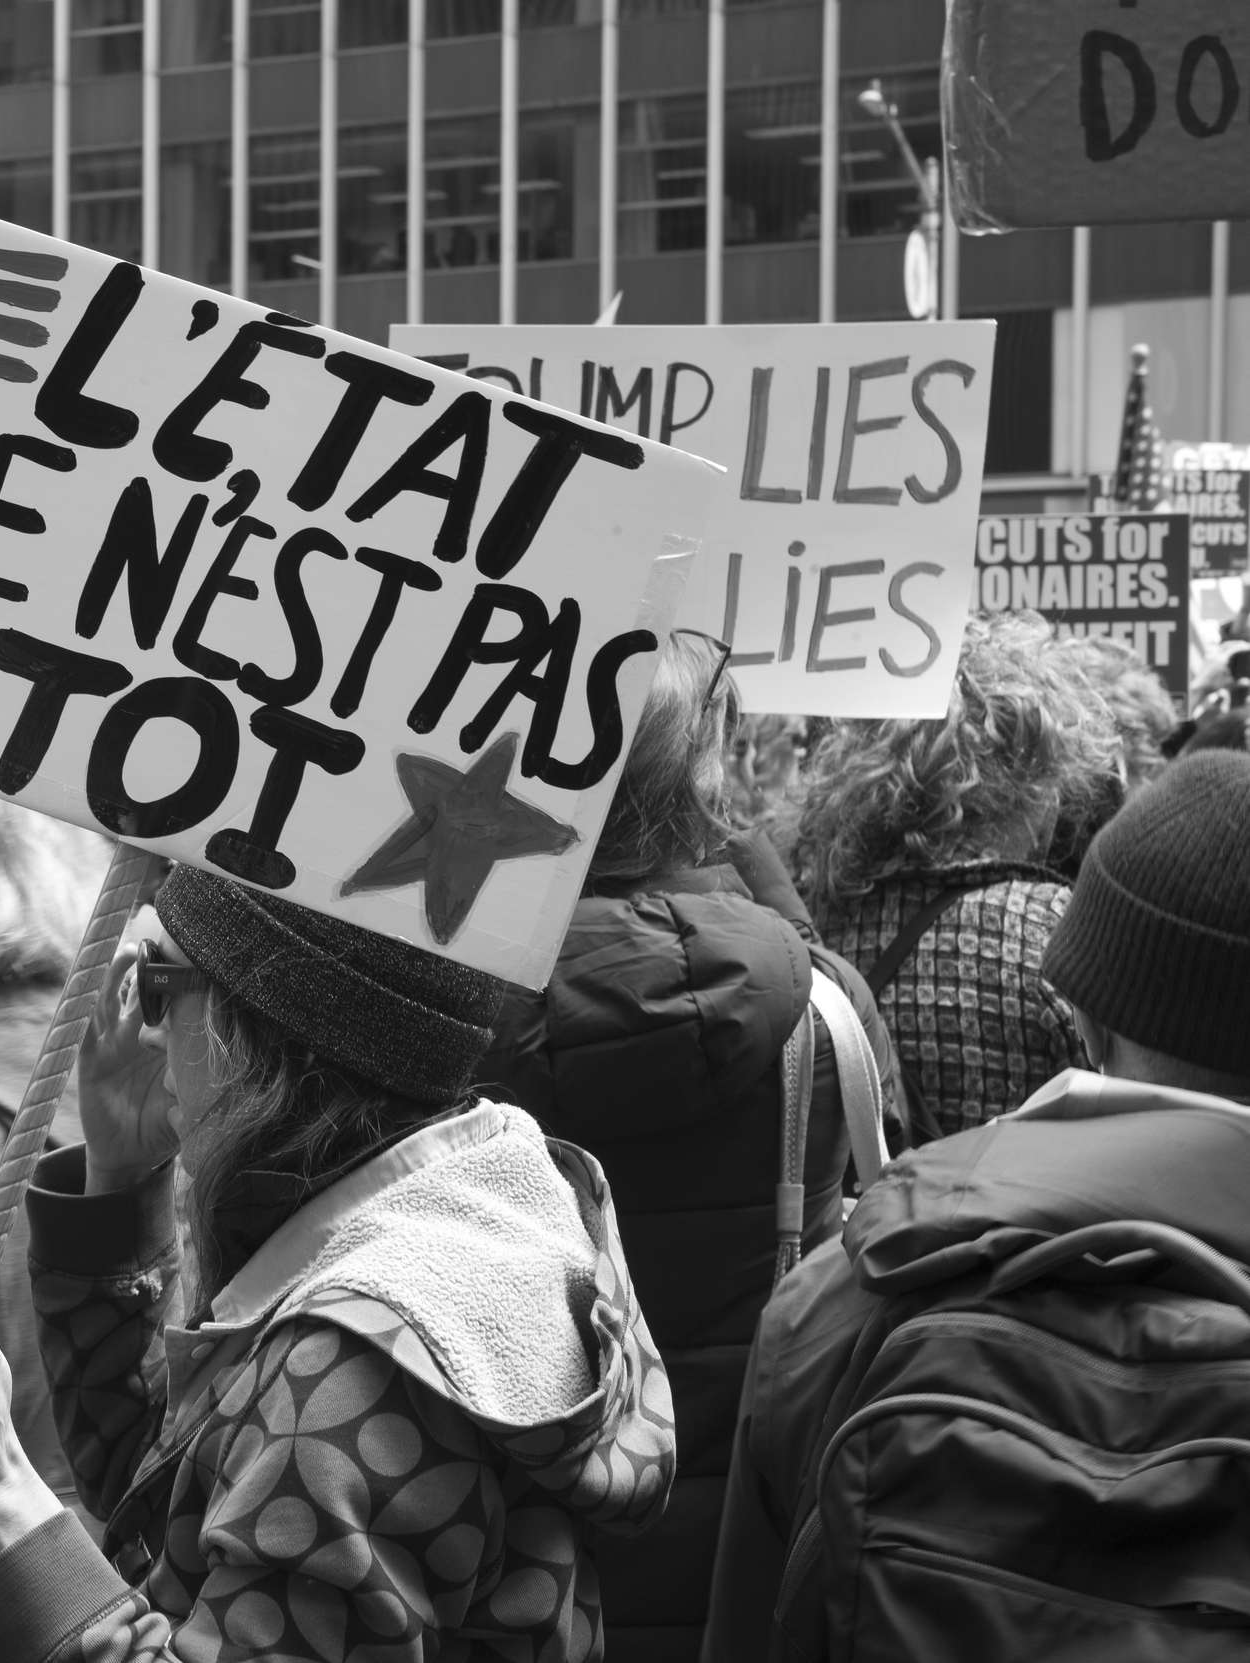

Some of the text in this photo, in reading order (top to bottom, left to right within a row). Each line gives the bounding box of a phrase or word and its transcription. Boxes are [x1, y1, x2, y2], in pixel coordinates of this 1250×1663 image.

[1080, 30, 1239, 162] DO
[740, 355, 976, 506] LIES
[977, 516, 1170, 563] CUTS for
[1190, 520, 1248, 546] CUTS
[75, 470, 443, 718] N'EST
[407, 584, 658, 791] PAS
